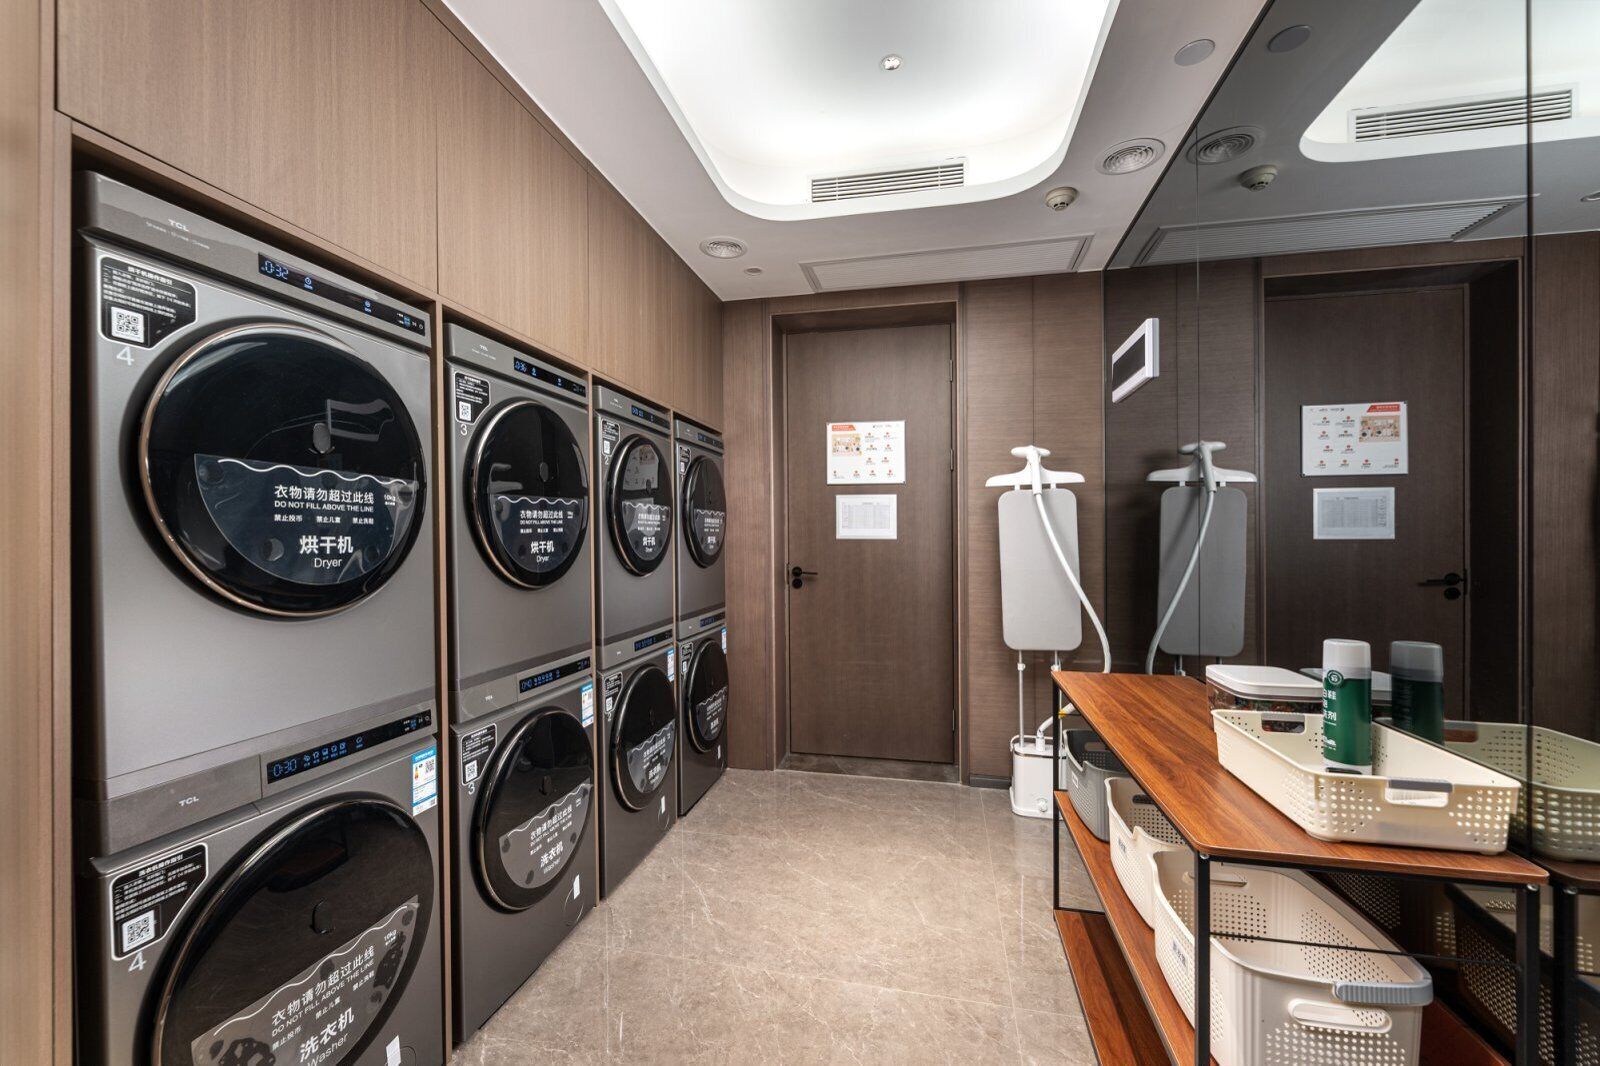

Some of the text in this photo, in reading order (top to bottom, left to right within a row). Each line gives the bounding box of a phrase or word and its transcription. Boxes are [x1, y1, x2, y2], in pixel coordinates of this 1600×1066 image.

[168, 219, 189, 232] TCL
[264, 260, 289, 280] 0:32
[116, 346, 135, 366] 4
[460, 424, 468, 436] 3
[274, 484, 375, 504] 衣物请勿超过此线
[274, 500, 287, 508] DO
[288, 501, 304, 509] NOT
[306, 502, 321, 510] FILL
[322, 503, 346, 511] ABOVE
[360, 505, 374, 513] LINE
[299, 535, 354, 555] 烘干机
[531, 540, 554, 554] 烘干机
[314, 557, 343, 569] Dryer
[468, 782, 475, 795] 3
[178, 795, 200, 807] TCL
[128, 951, 147, 972] 4
[271, 945, 375, 1026] 衣物请勿超过此线
[271, 959, 374, 1038] DO NOT FILL ABOVE THE LINE
[300, 1007, 355, 1063] 洗衣机
[307, 1033, 349, 1066] Washer
